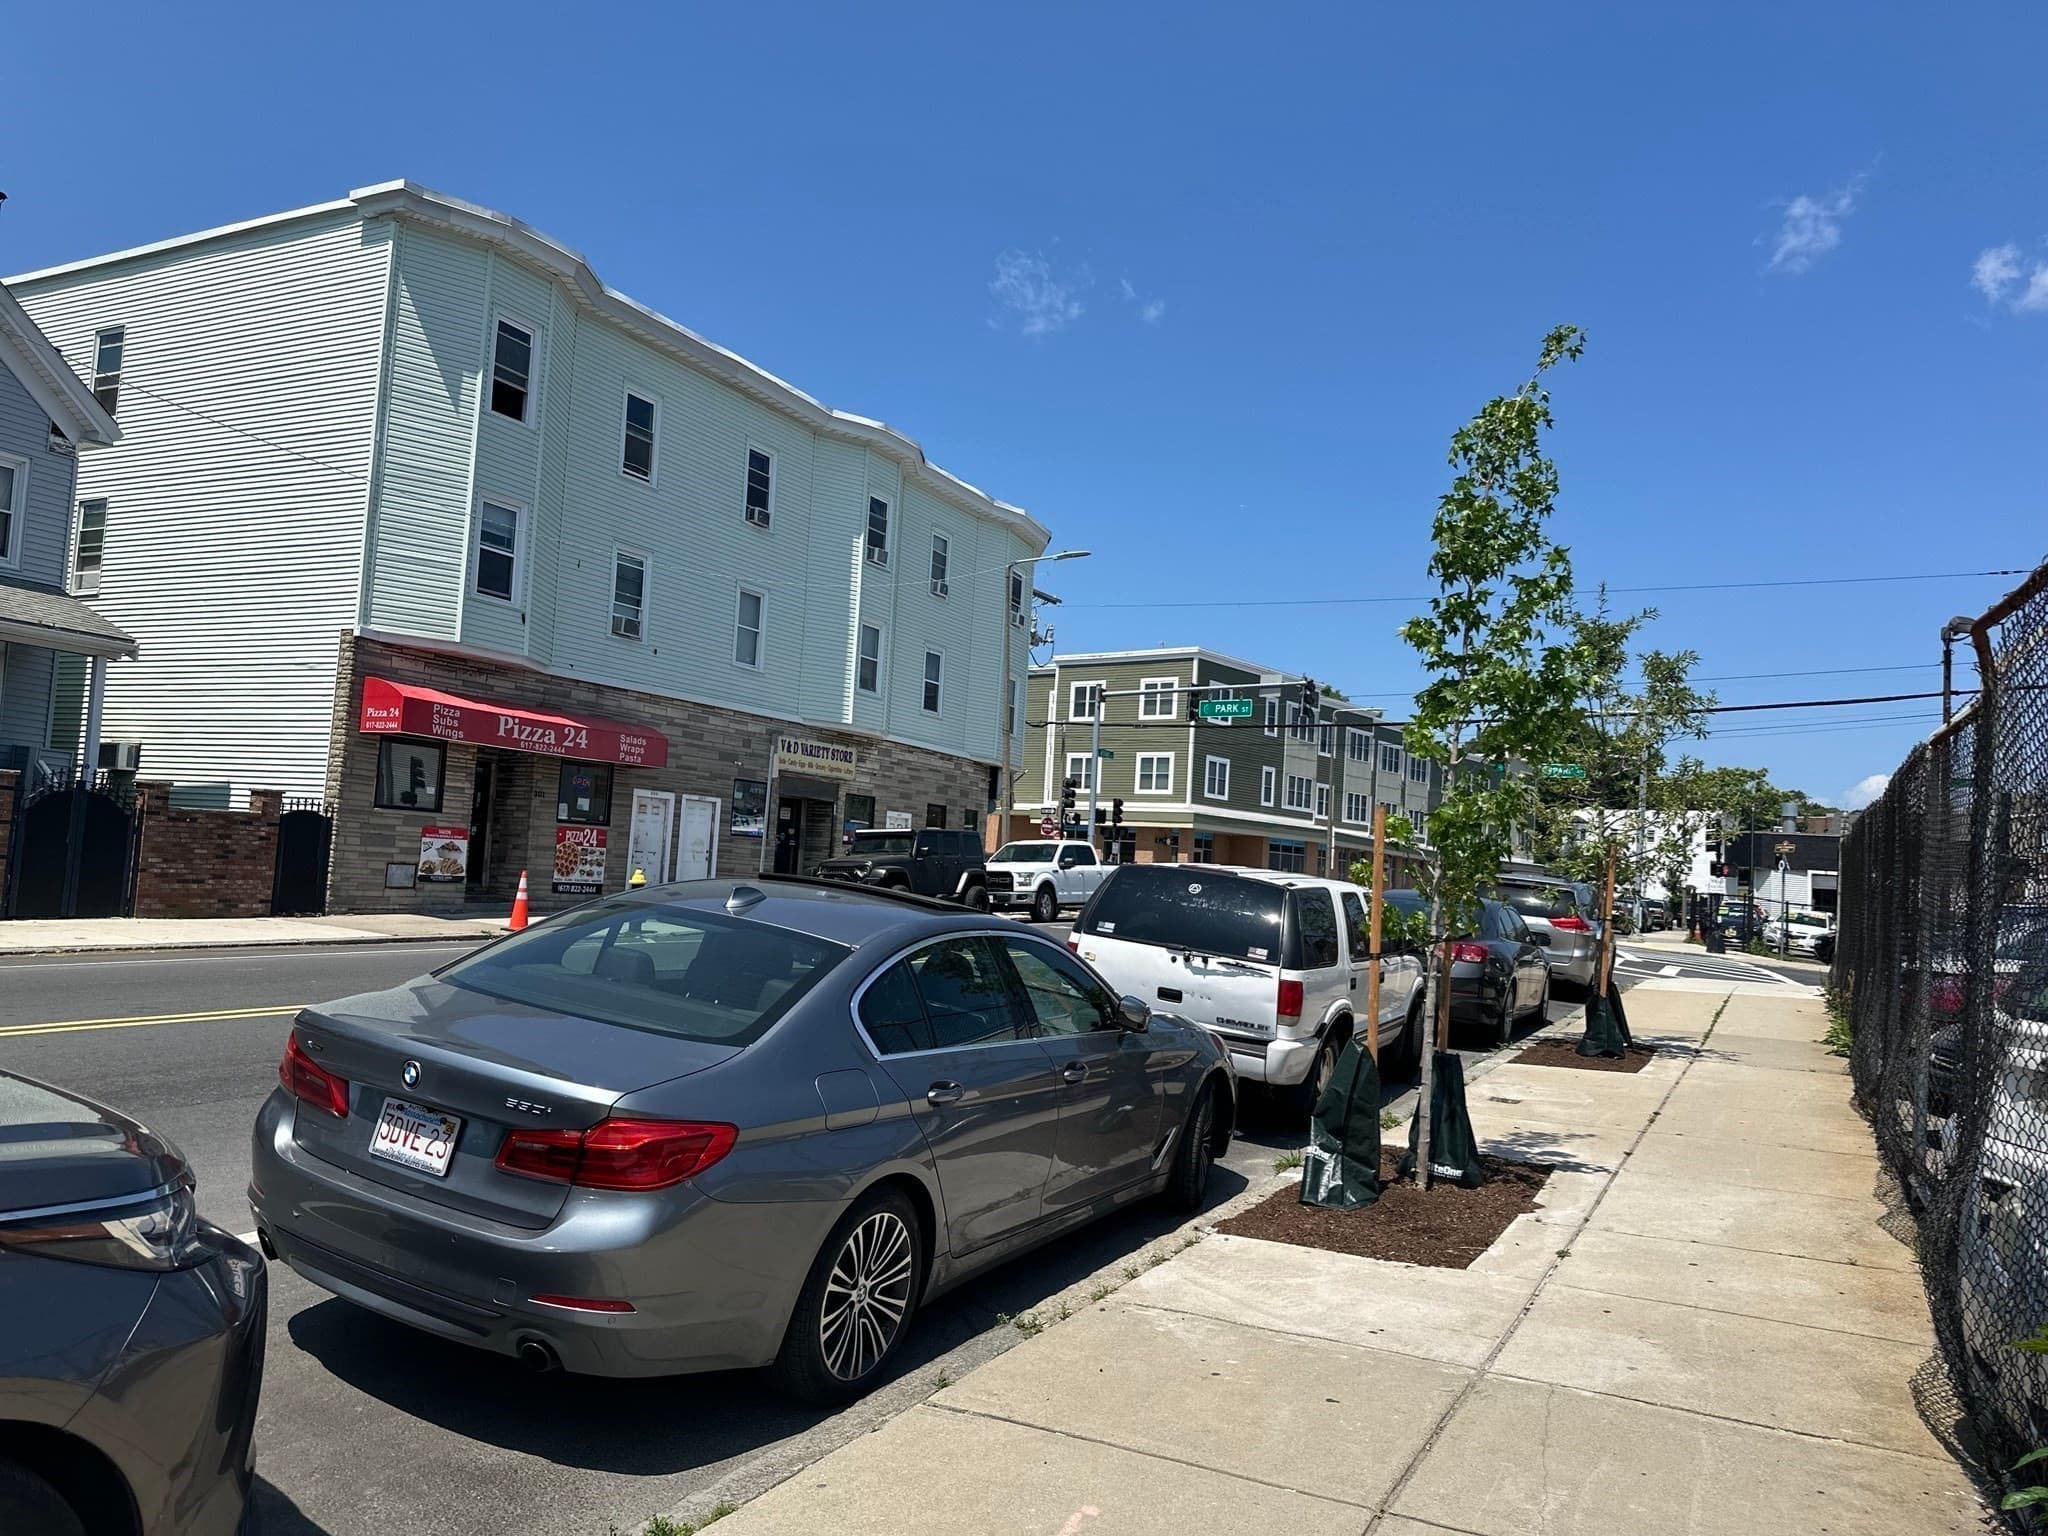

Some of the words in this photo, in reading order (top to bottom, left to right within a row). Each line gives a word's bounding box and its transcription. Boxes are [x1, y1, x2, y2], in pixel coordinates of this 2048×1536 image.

[366, 707, 388, 718] Pizza
[389, 707, 400, 717] 24
[432, 703, 461, 718] Pizza
[1215, 704, 1239, 713] PARK
[365, 720, 399, 729] 617-822-2444
[432, 713, 459, 728] Subs
[432, 723, 465, 740] Wings
[497, 715, 556, 745] Pizza
[562, 727, 589, 749] 24
[520, 741, 566, 754] 617-822-2444
[619, 734, 647, 746] Salads
[619, 743, 646, 758] Wraps
[619, 752, 642, 764] Pasta
[781, 739, 787, 752] V
[793, 742, 799, 754] D
[800, 743, 831, 760] VARIETY
[830, 748, 854, 764] STORE
[565, 830, 584, 844] PIZZA
[583, 828, 598, 847] 24
[380, 1112, 427, 1153] 3DVE
[424, 1128, 453, 1160] 23
